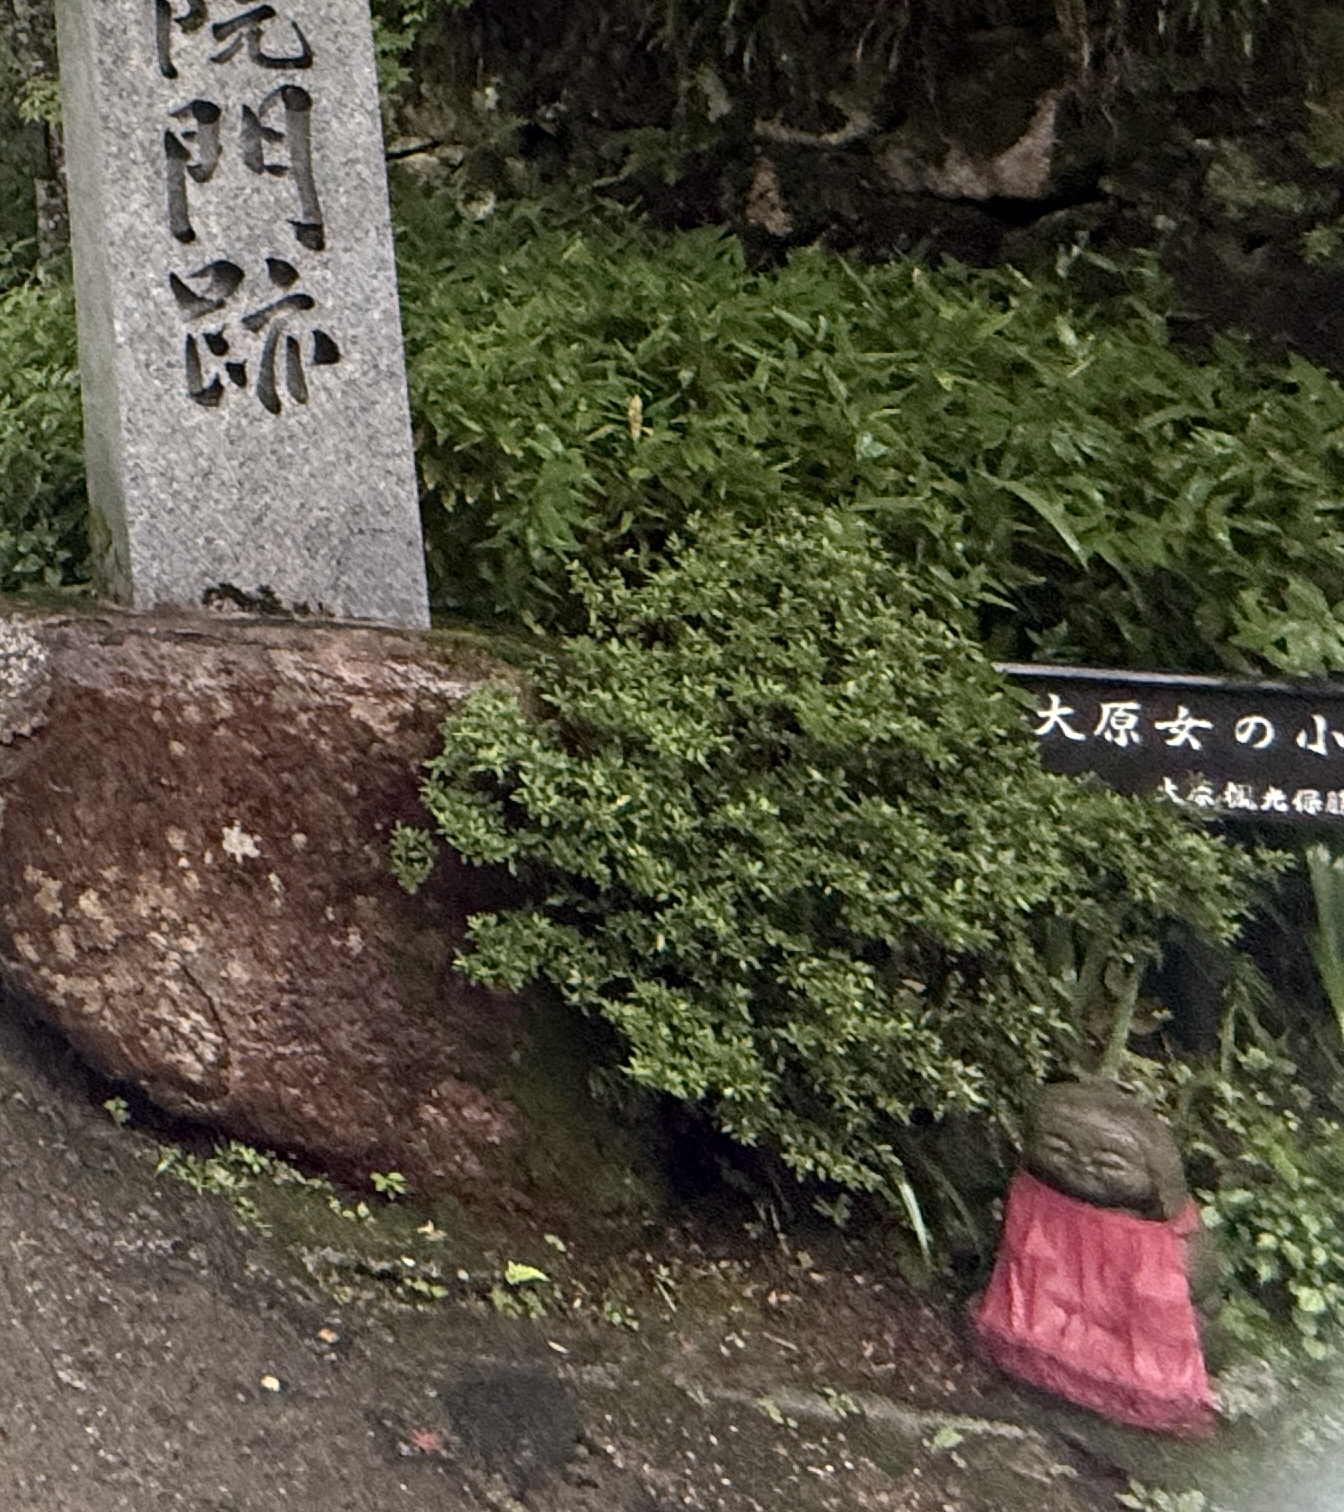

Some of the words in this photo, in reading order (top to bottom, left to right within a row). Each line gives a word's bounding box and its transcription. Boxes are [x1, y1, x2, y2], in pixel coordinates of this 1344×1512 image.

[1034, 692, 1344, 756] 大原女の小
